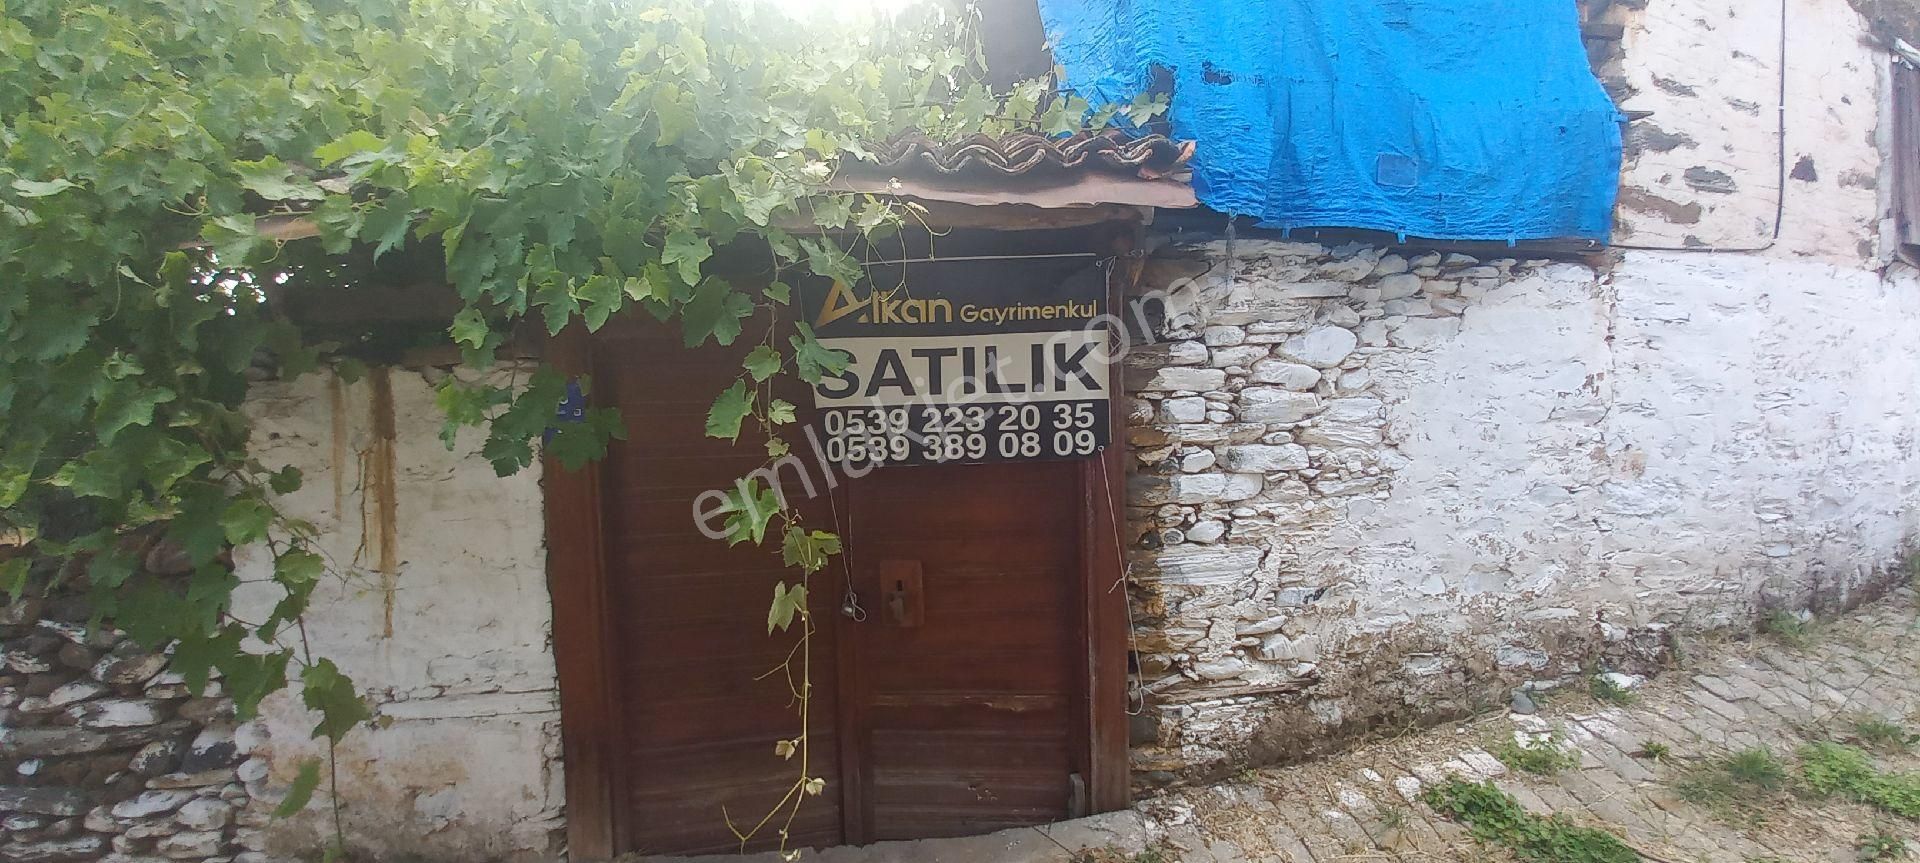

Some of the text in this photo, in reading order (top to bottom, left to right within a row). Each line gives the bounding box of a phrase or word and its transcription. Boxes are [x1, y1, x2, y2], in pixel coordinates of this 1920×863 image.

[960, 299, 1097, 326] Gayrimenkul
[817, 341, 1104, 399] SATILIK
[825, 402, 1095, 436] 0539 223 20 35
[827, 429, 1096, 462] 0539 389 08 09
